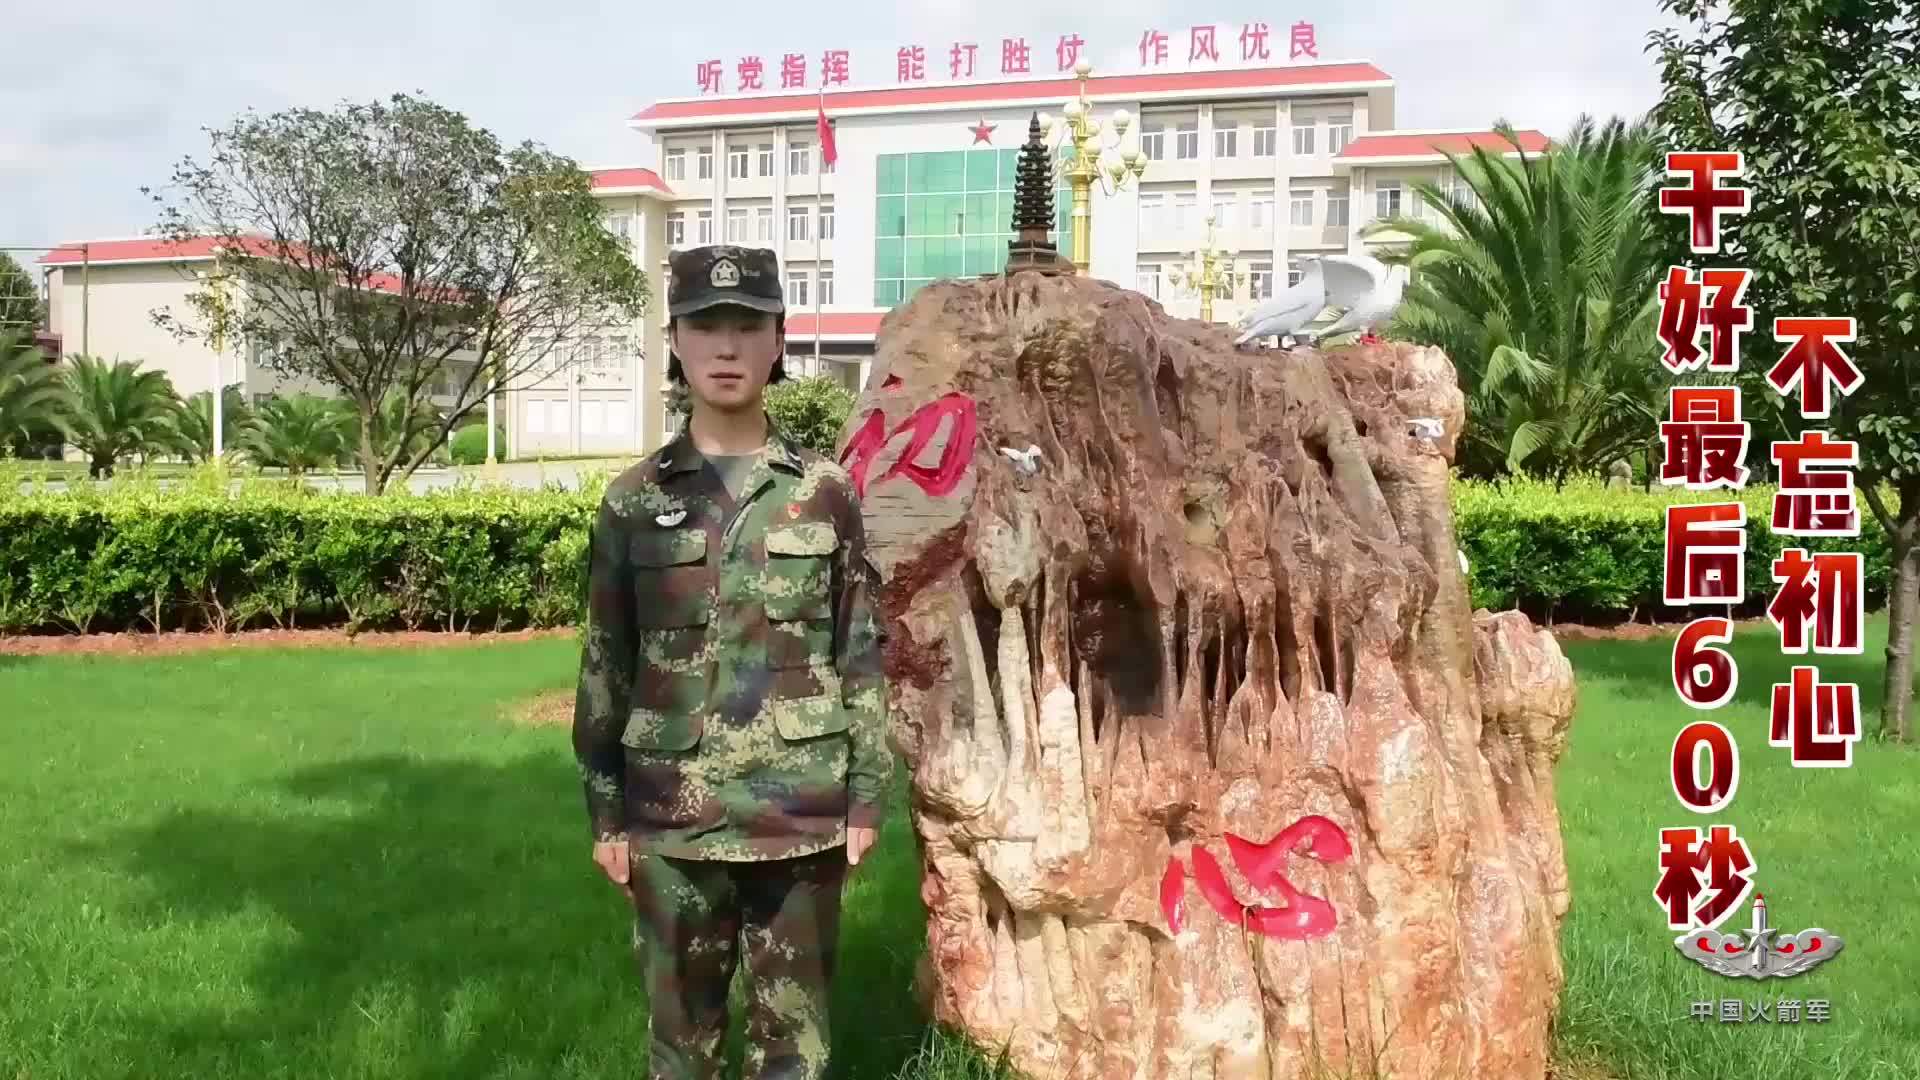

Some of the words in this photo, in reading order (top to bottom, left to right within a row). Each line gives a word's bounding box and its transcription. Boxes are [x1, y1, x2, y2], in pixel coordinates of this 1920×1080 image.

[697, 49, 850, 94] 听党指挥
[897, 33, 1085, 82] 能打胜仗
[1139, 20, 1319, 66] 作风优良
[1159, 815, 1352, 941] 心
